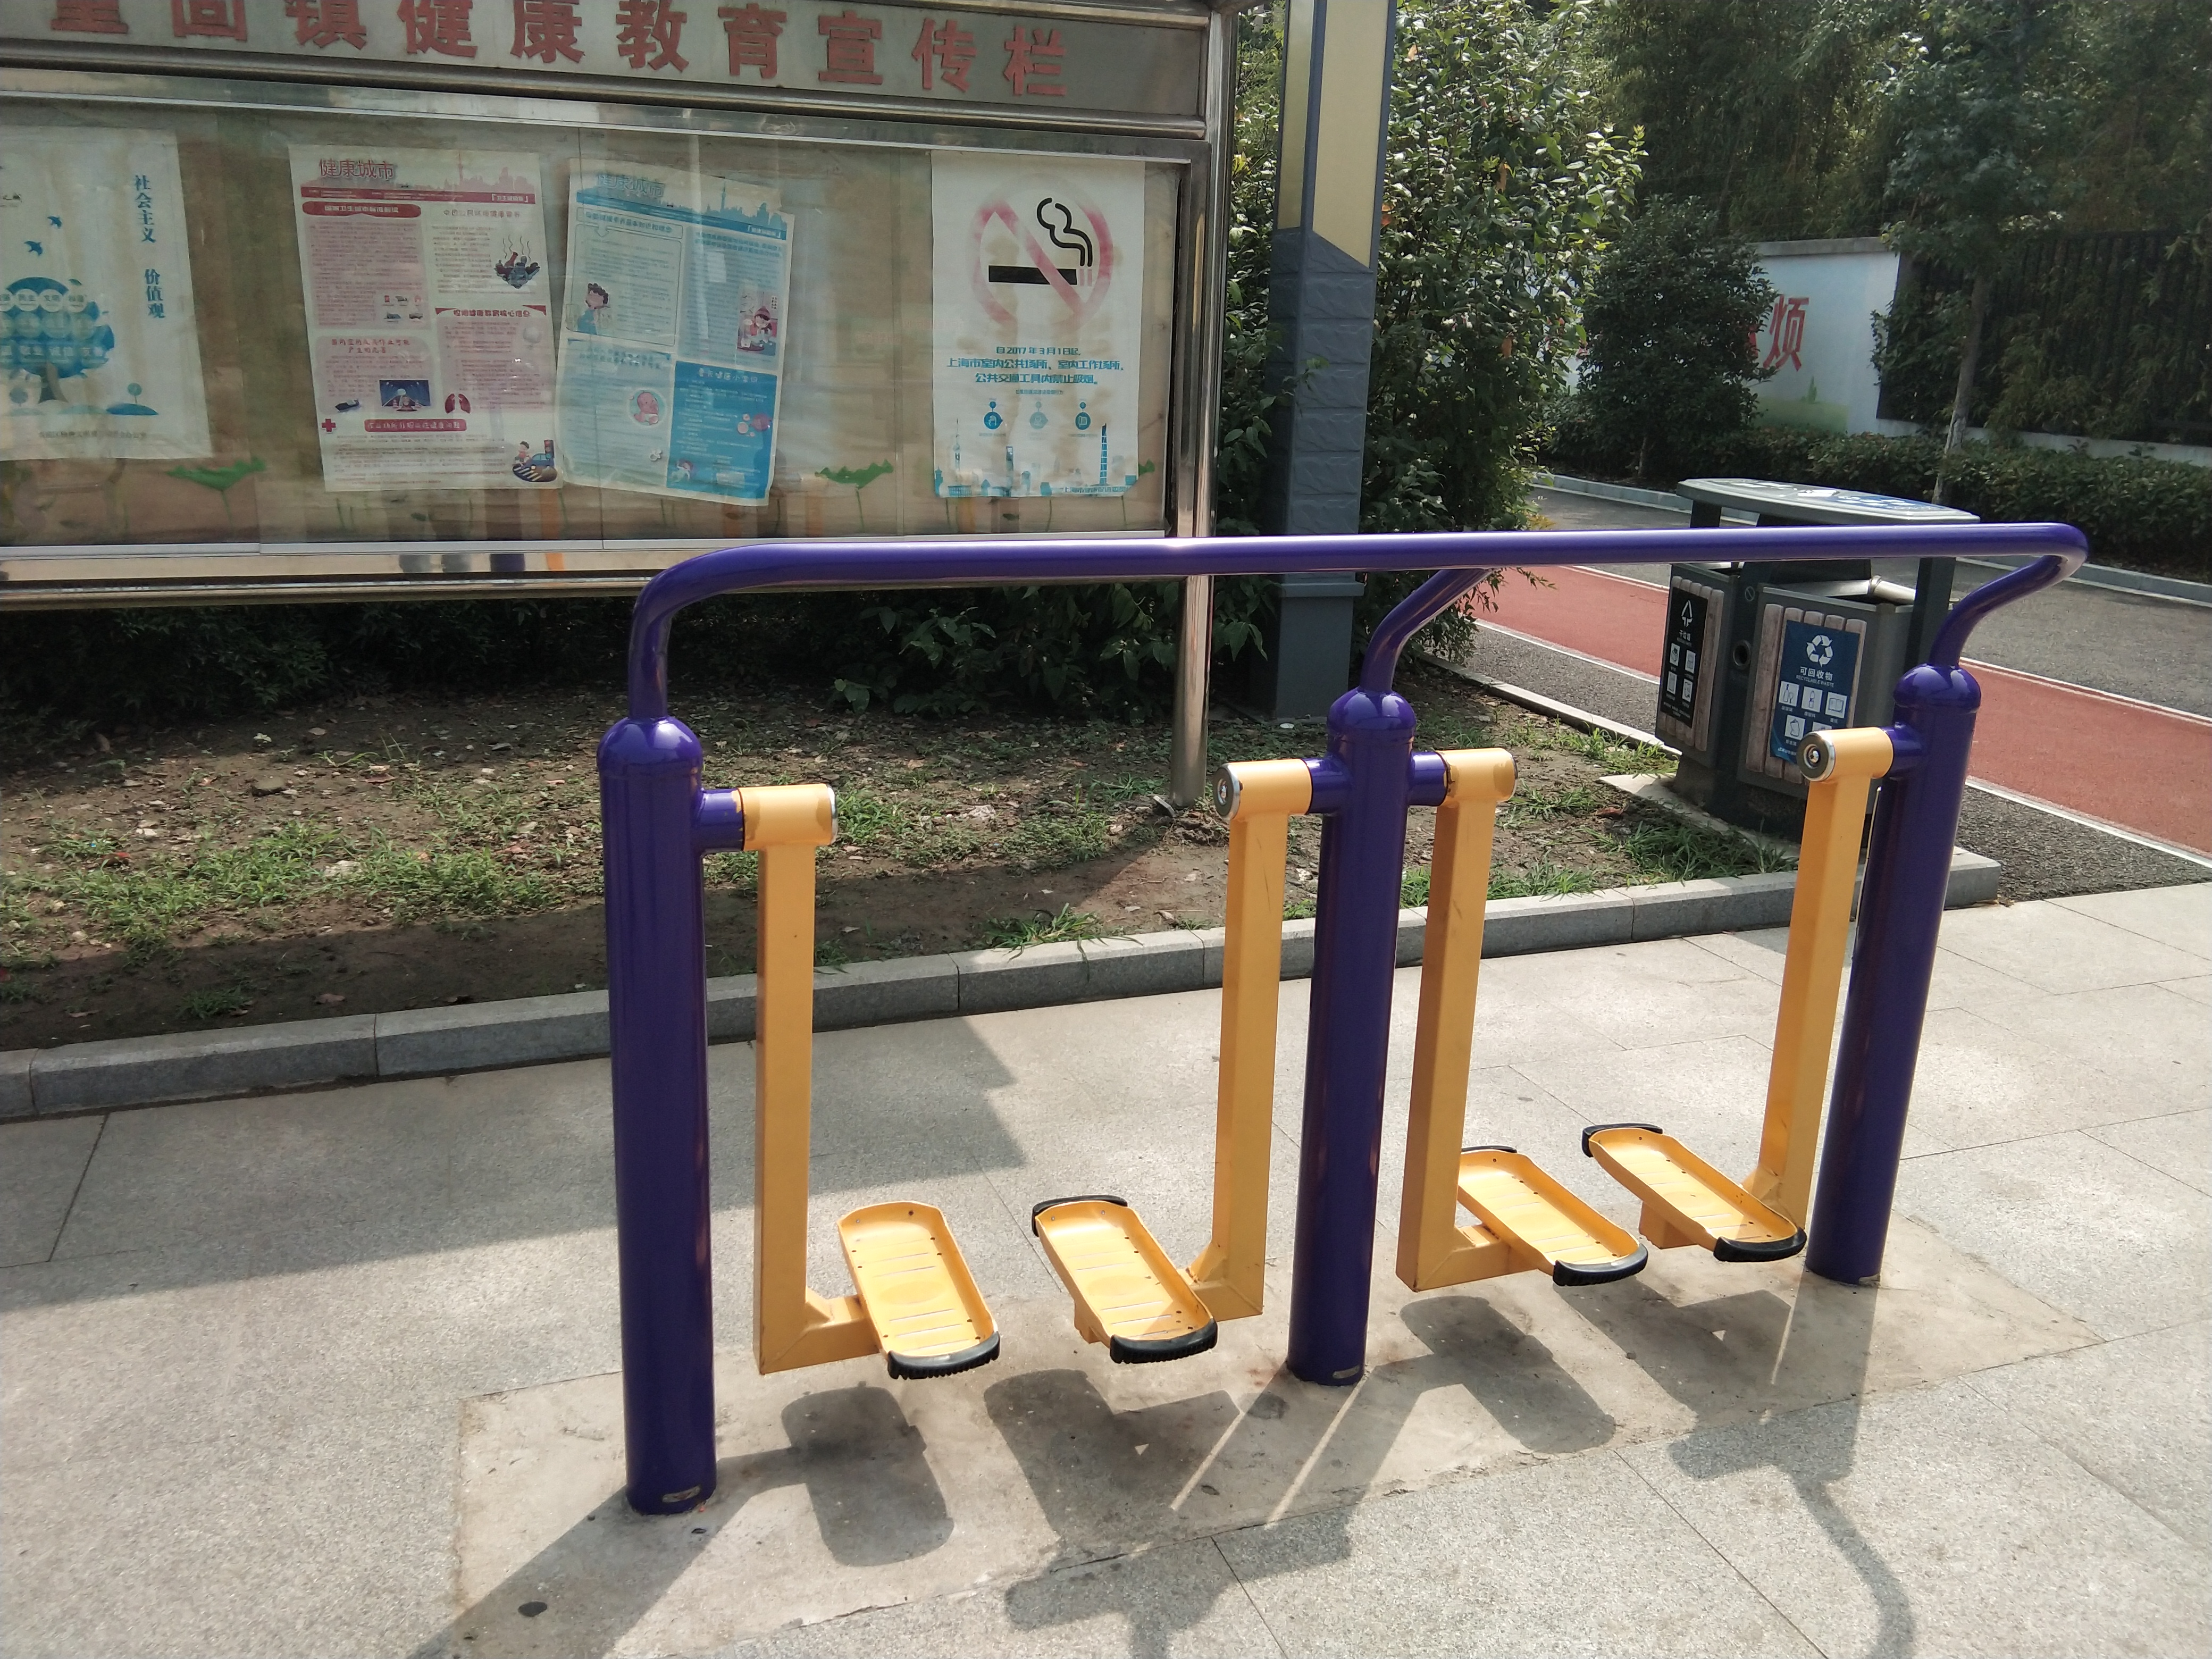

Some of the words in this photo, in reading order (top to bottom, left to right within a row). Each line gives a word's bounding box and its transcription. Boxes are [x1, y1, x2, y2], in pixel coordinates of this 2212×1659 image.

[319, 158, 395, 180] 健康城市
[135, 175, 156, 243] 社会主义
[144, 269, 165, 319] 价值观
[1763, 294, 1809, 371] 烦
[1800, 666, 1833, 681] 可回收物
